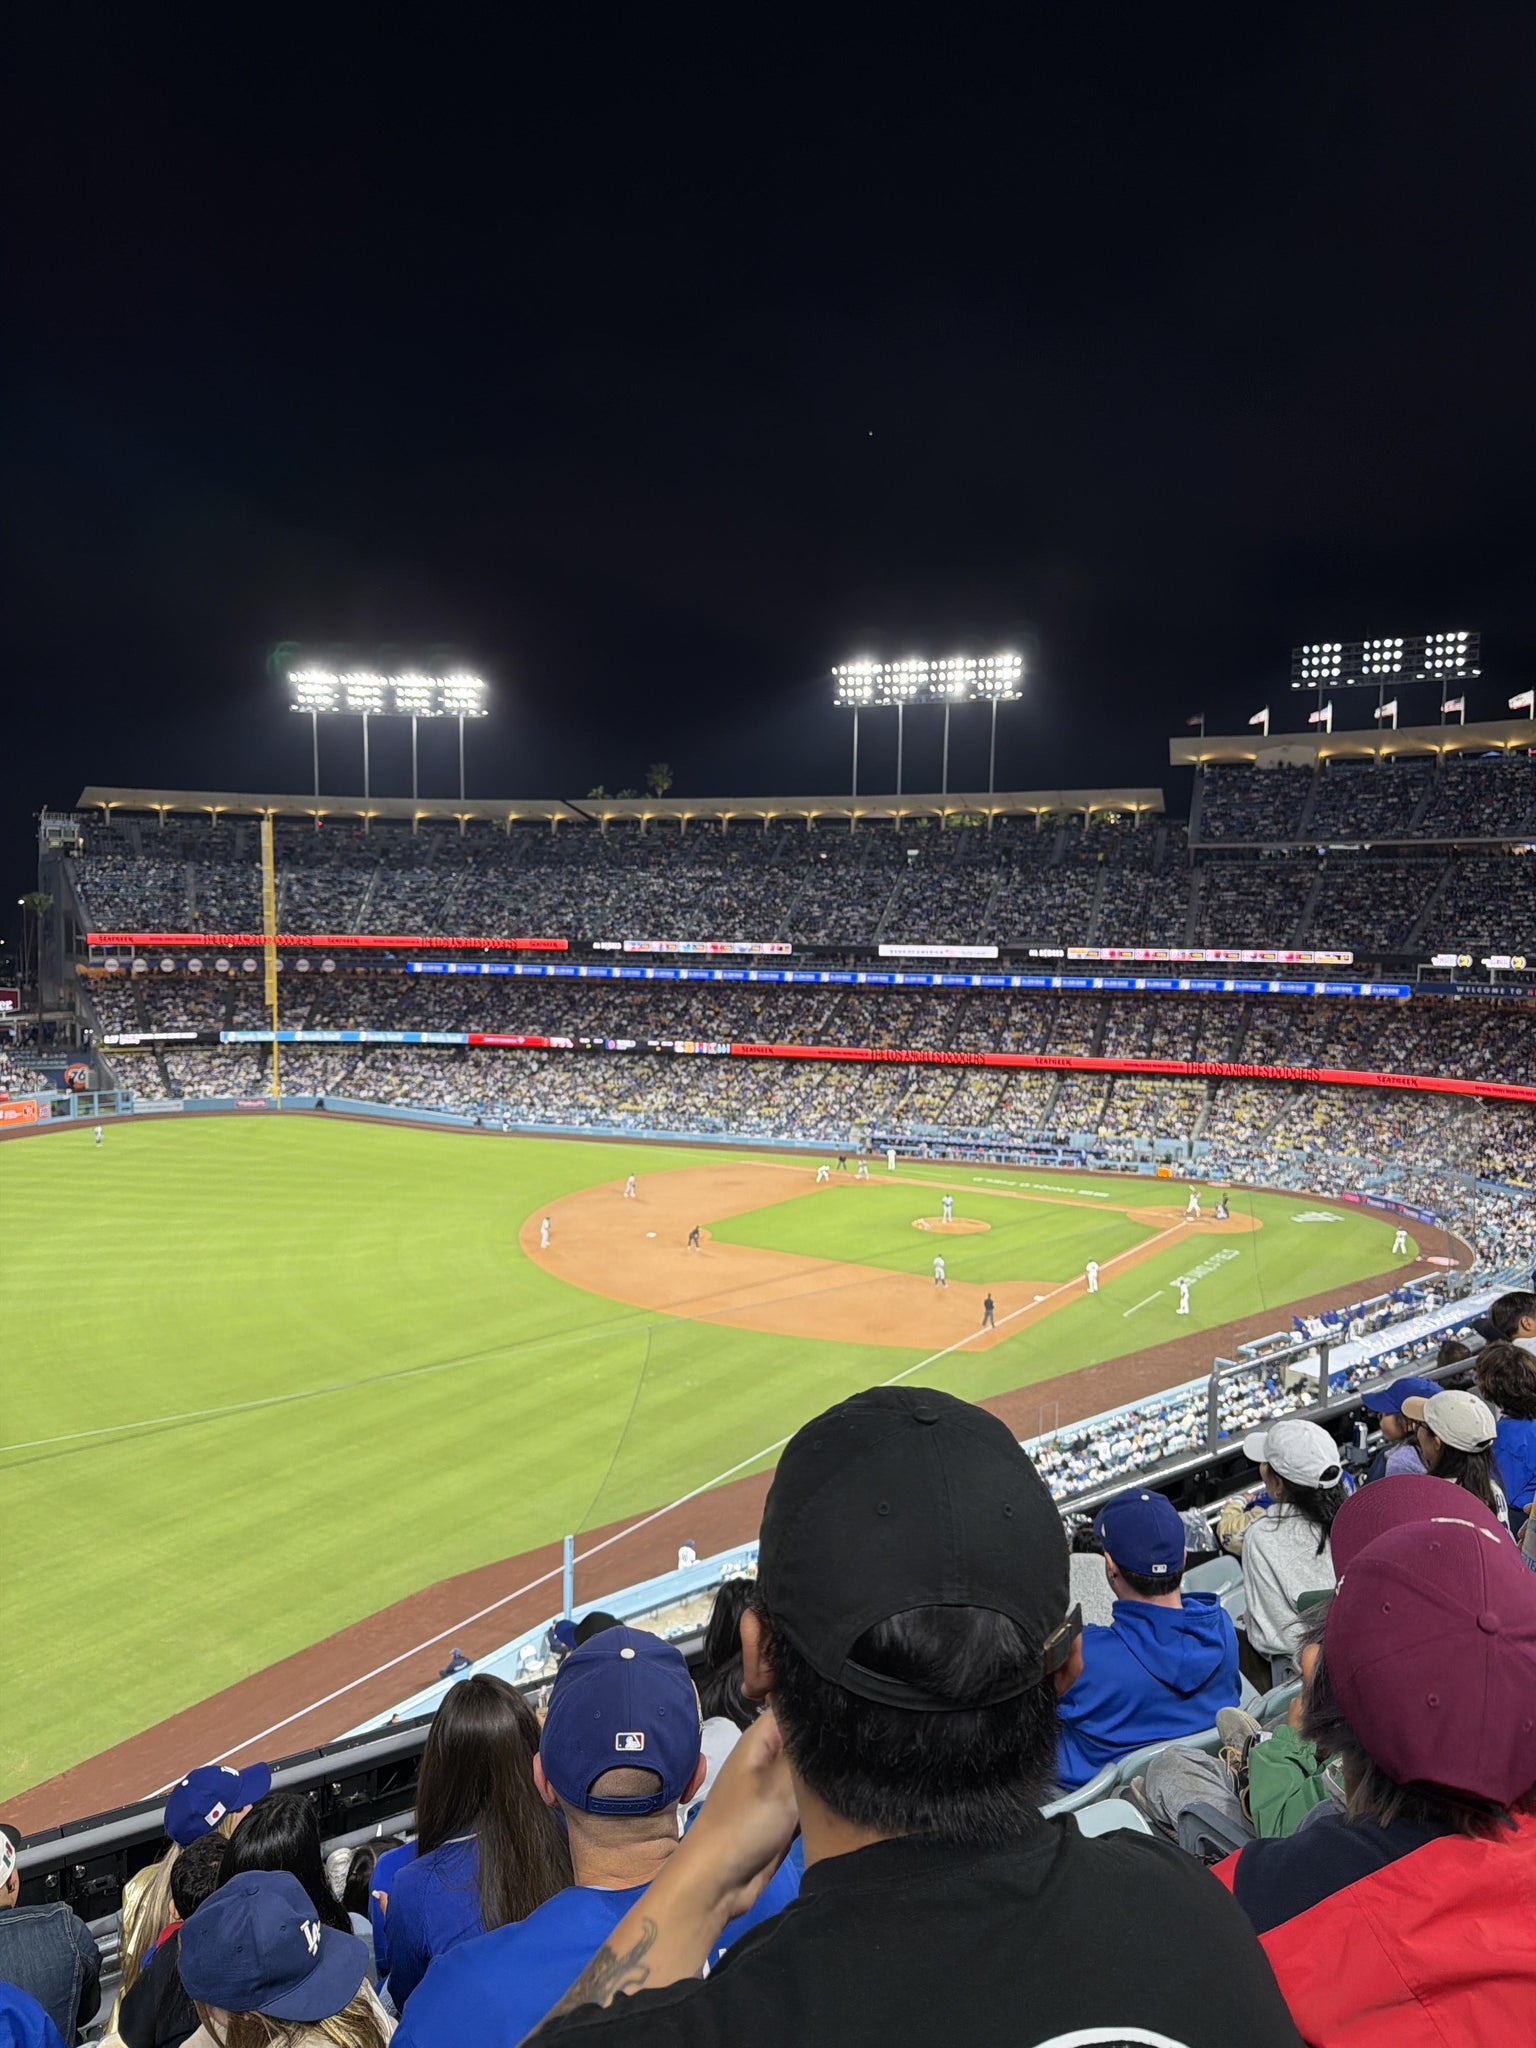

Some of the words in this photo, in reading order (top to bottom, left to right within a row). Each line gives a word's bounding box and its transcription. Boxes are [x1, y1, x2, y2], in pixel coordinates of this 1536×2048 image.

[1456, 985, 1505, 995] WELCOME
[1510, 987, 1523, 995] TO
[1035, 1057, 1072, 1066] SEATGEEK
[70, 1070, 87, 1081] 76
[1376, 1075, 1418, 1088] SEATGEEK
